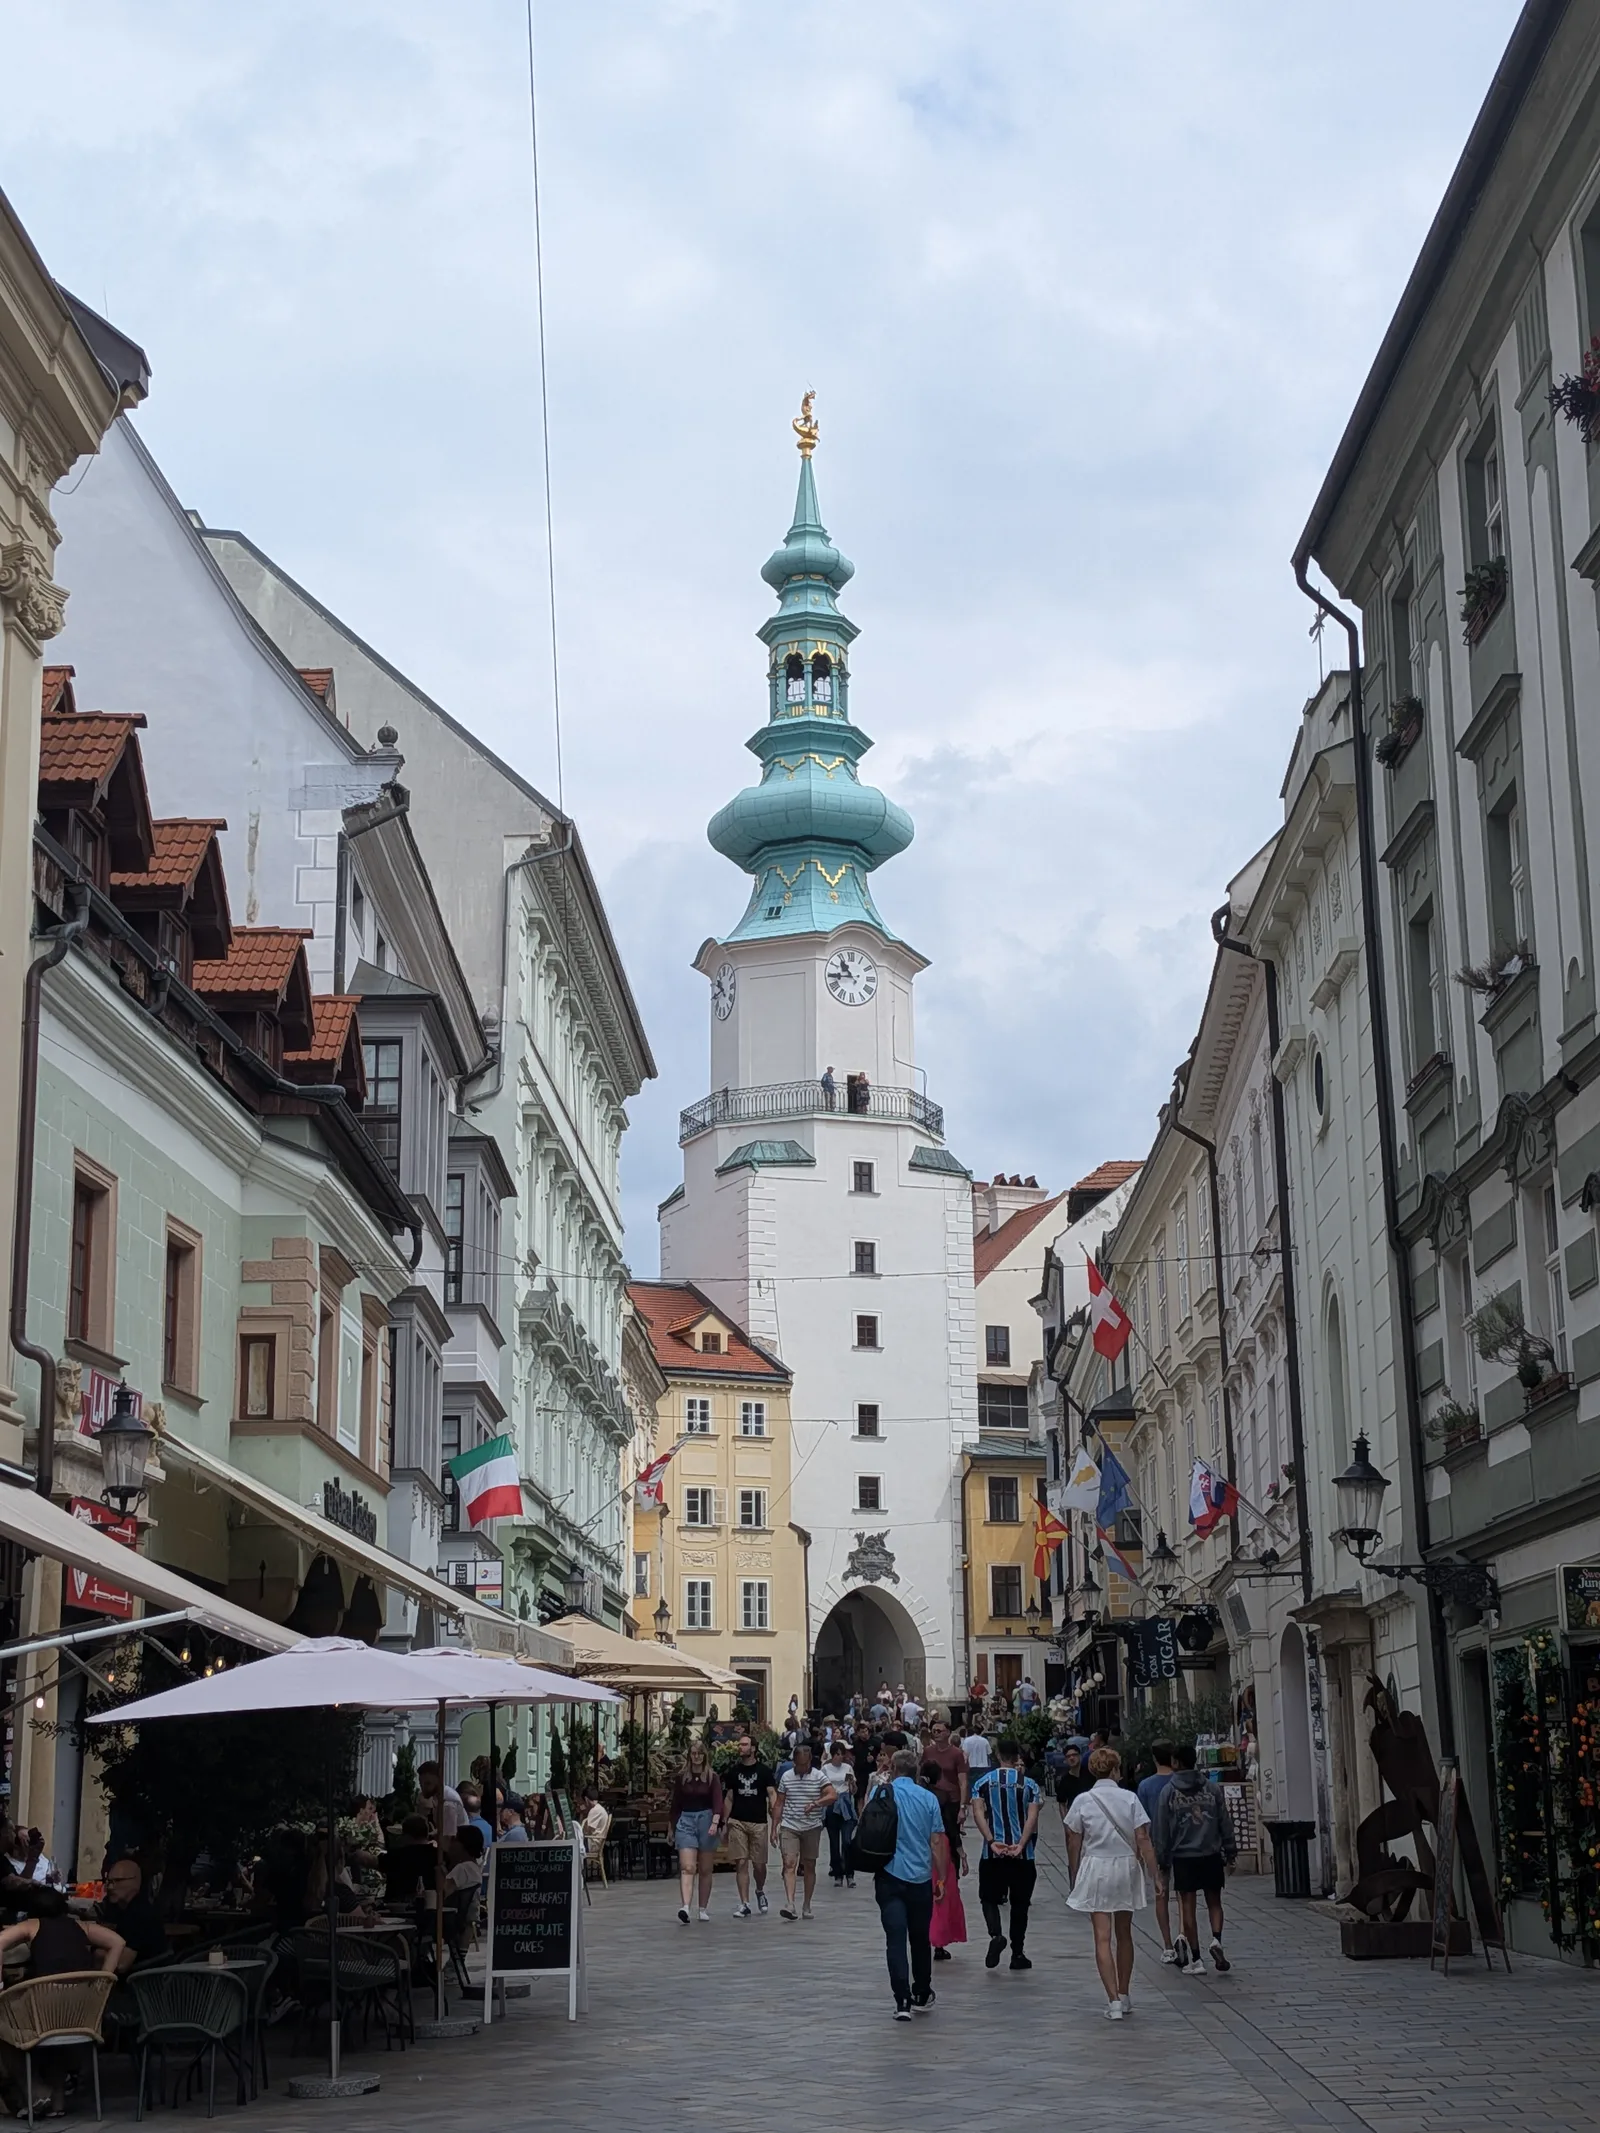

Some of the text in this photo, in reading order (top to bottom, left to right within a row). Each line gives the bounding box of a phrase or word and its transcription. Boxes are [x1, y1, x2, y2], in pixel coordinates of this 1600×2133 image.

[1156, 1620, 1176, 1678] CIGÁR
[1149, 1655, 1159, 1679] DOM
[501, 1849, 573, 1863] BENEDICT EGGS
[500, 1878, 538, 1890] ENGLISH
[521, 1892, 569, 1905] BREAKFAST
[501, 1909, 546, 1920] CROISSANT
[496, 1923, 565, 1936] HUMMUS PLATE
[514, 1941, 544, 1953] CAKES
